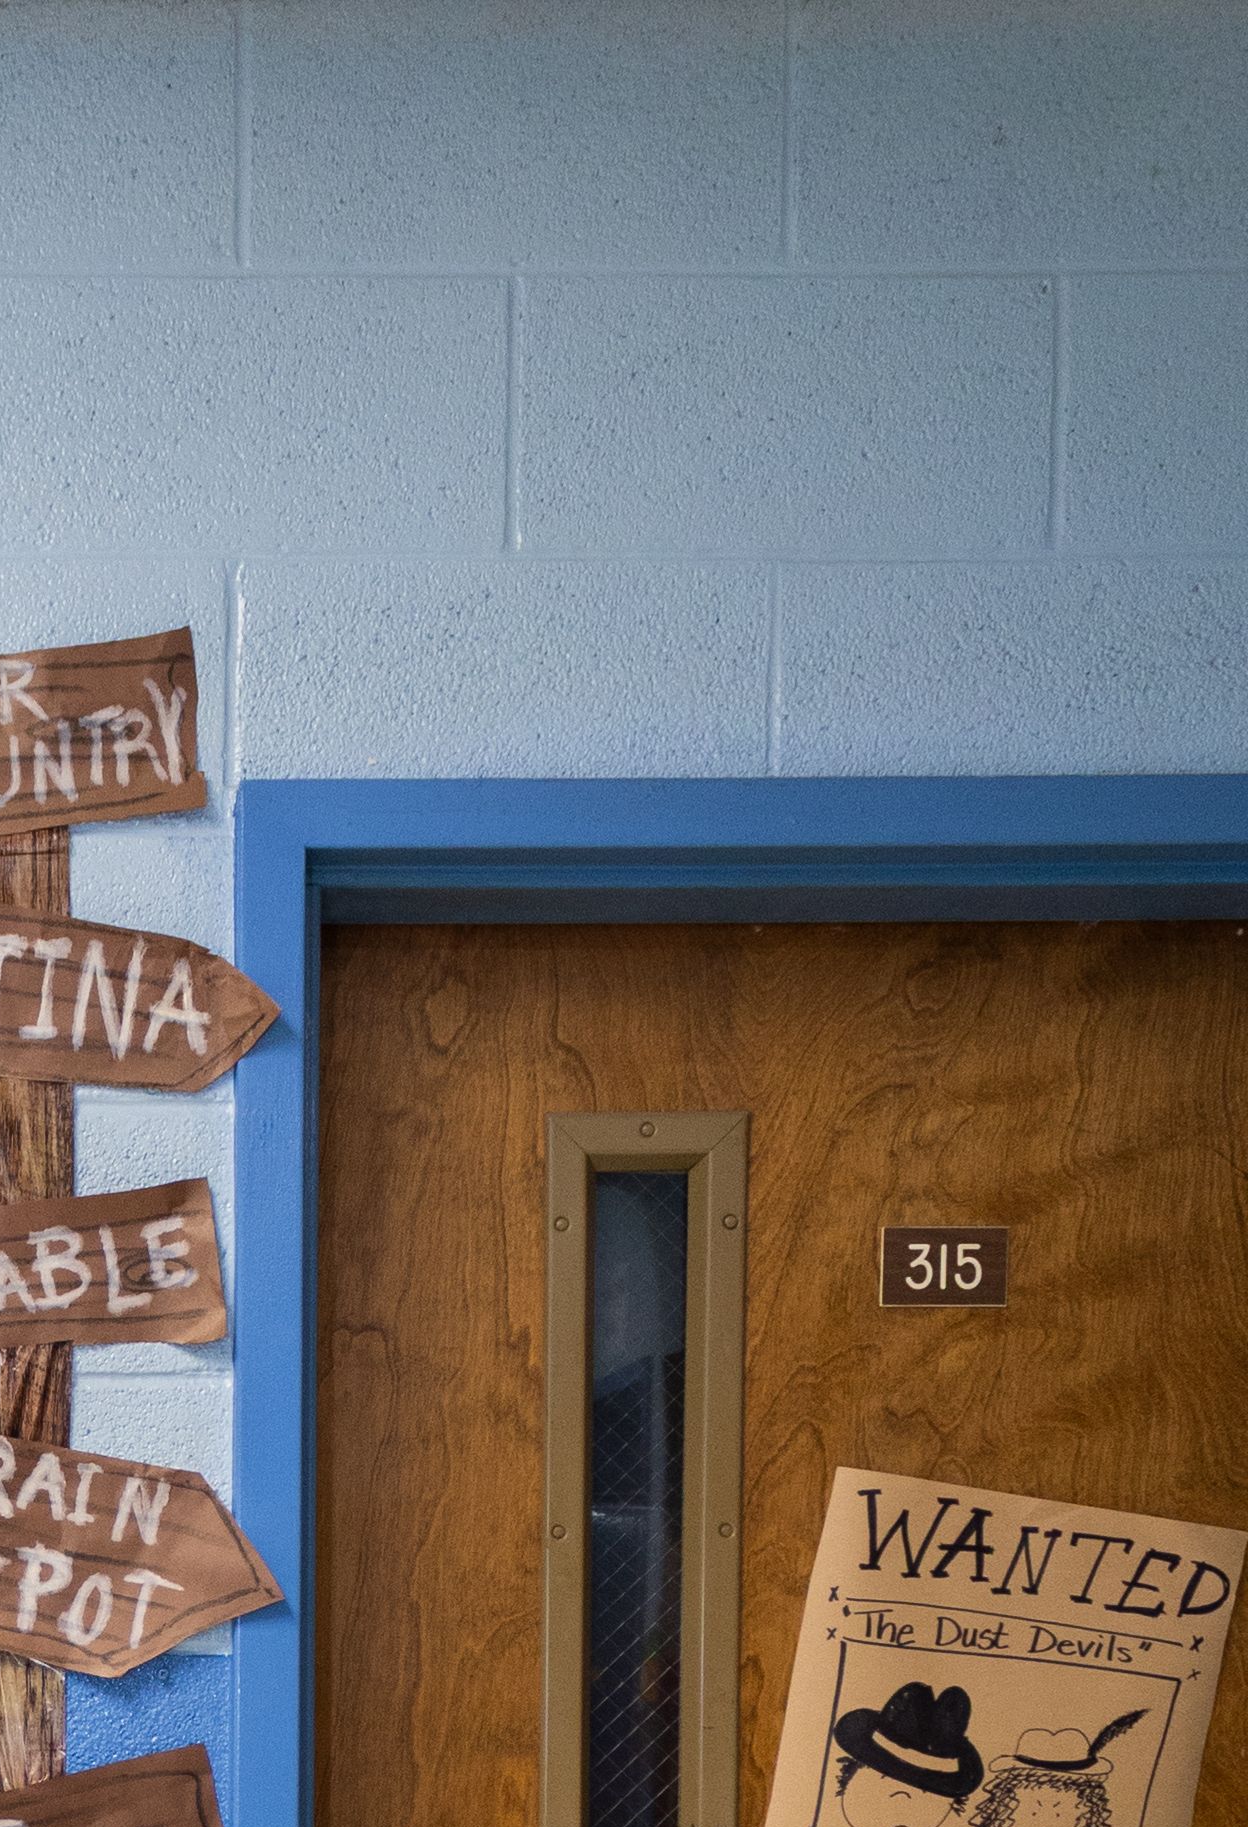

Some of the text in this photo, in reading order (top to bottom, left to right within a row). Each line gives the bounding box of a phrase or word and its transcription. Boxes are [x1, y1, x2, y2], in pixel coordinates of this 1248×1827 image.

[905, 1243, 983, 1290] 315
[857, 1488, 1231, 1618] WANTED
[935, 1616, 1009, 1650] Dust
[1027, 1625, 1153, 1663] Devils"
